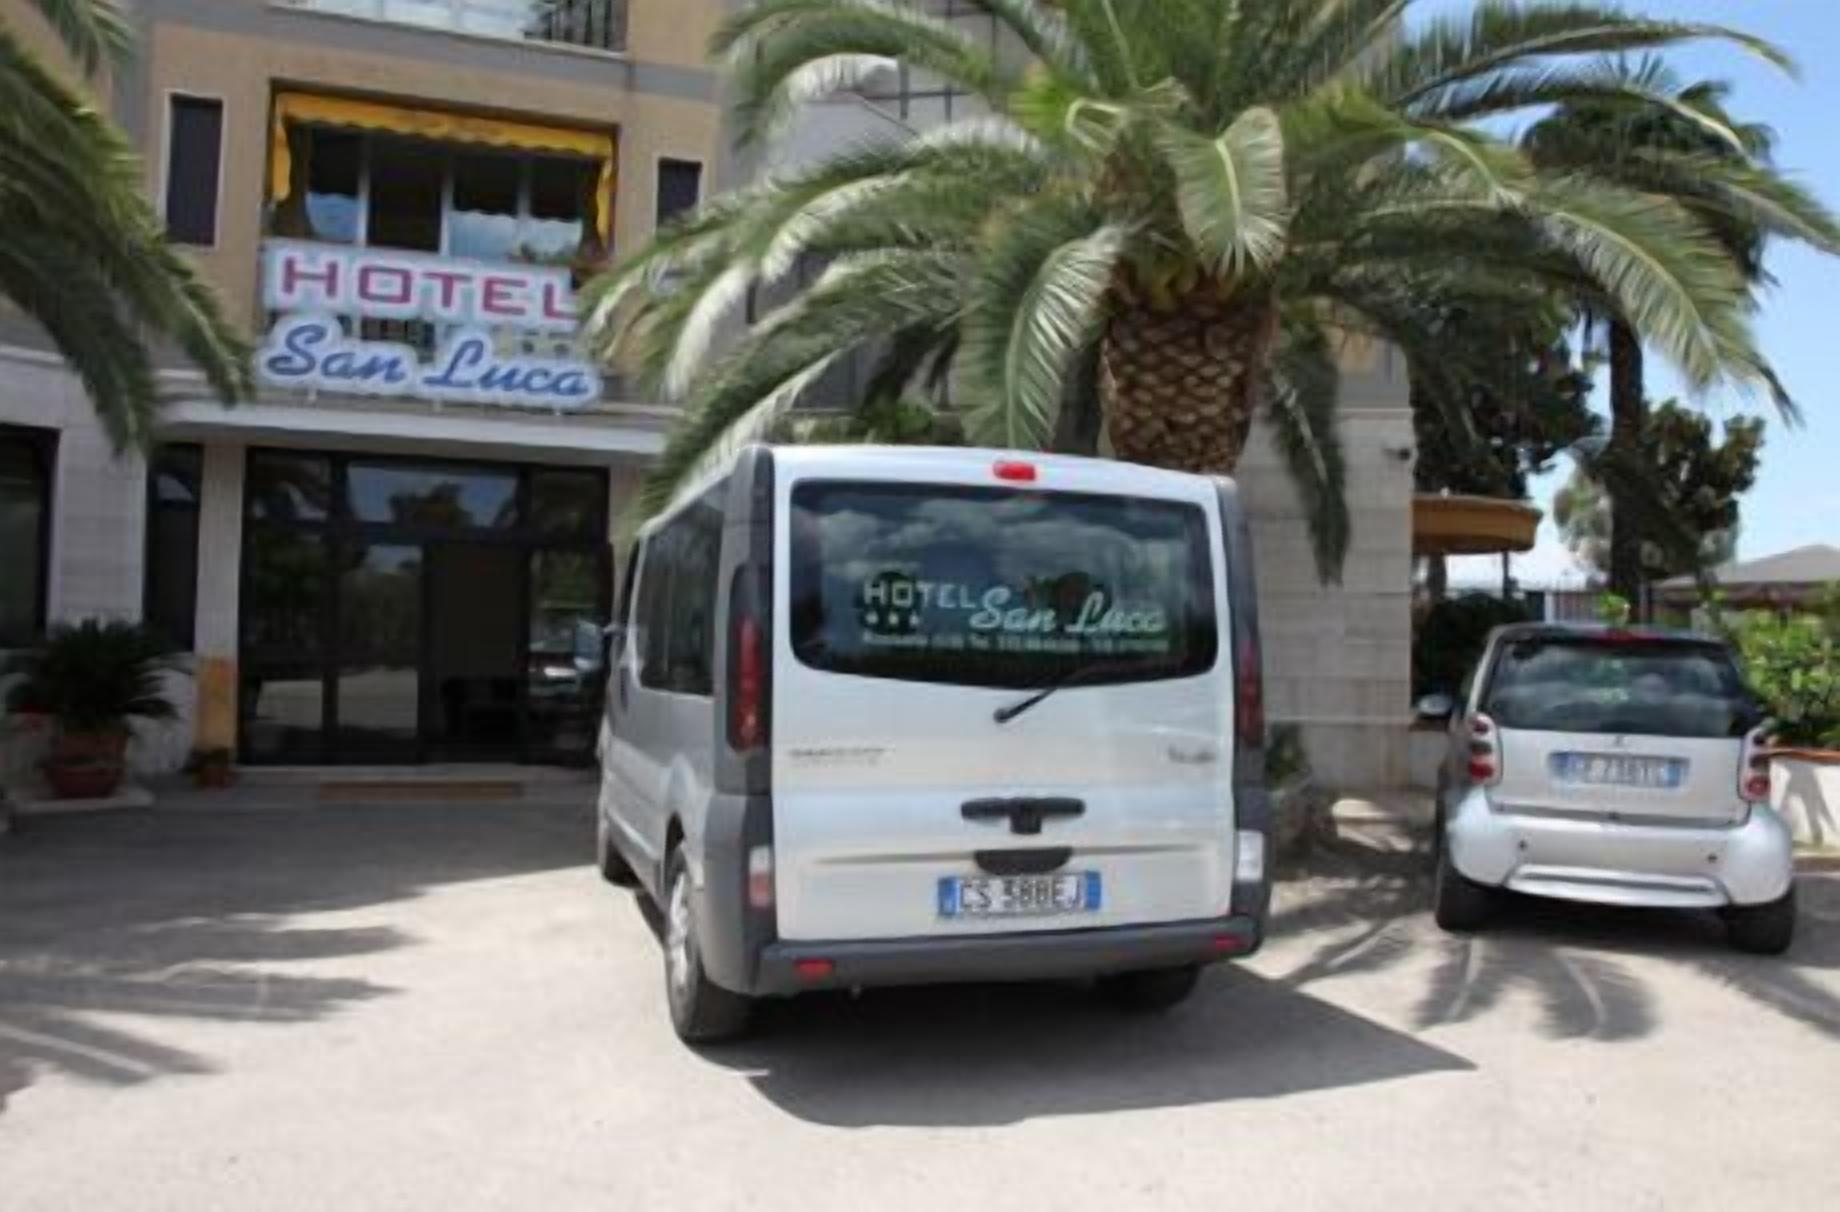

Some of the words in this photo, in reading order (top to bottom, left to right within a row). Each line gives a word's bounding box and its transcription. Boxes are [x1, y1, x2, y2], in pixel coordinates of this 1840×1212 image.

[281, 255, 580, 320] HOTEL
[265, 323, 407, 384] San
[421, 338, 590, 396] Luca
[863, 577, 977, 610] HOTEL
[969, 585, 1058, 631] San
